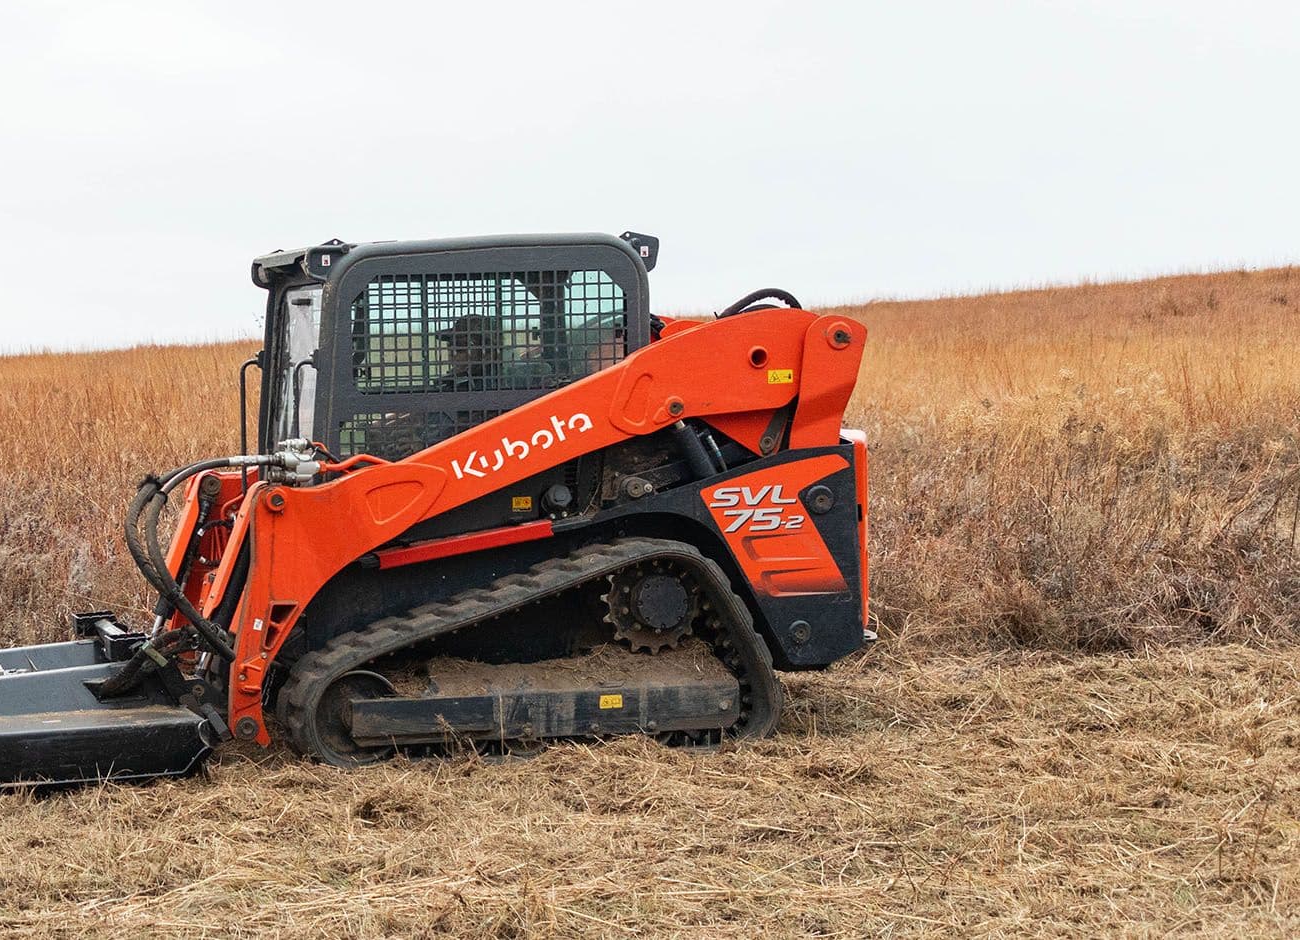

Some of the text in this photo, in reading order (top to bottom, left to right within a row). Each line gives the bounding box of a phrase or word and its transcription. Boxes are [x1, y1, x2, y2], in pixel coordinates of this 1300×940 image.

[451, 413, 593, 479] Kubota
[709, 484, 797, 507] SVL
[723, 507, 804, 533] 75-2
